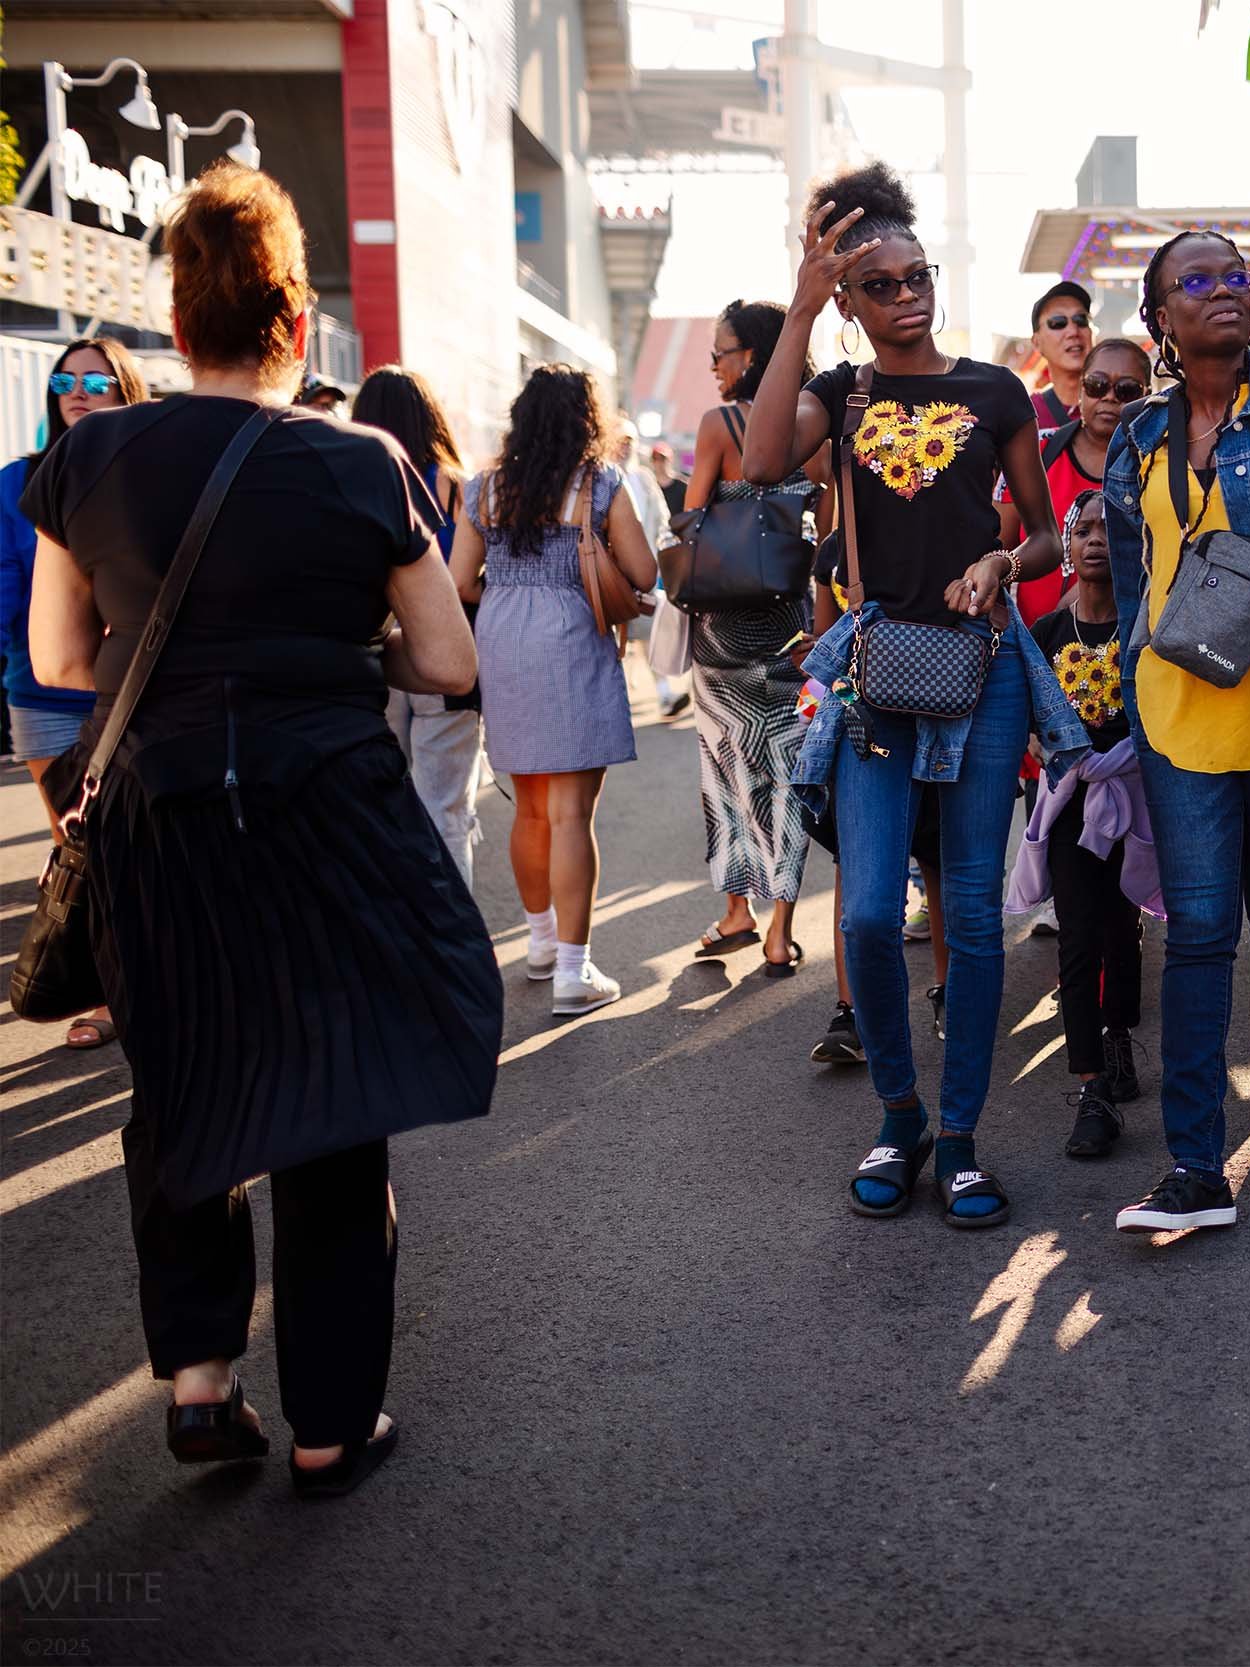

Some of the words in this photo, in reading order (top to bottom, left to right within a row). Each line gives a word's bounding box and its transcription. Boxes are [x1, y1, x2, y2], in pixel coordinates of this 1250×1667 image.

[1207, 650, 1235, 672] CANADA
[867, 1147, 898, 1161] NIKE
[955, 1171, 982, 1183] NIKE
